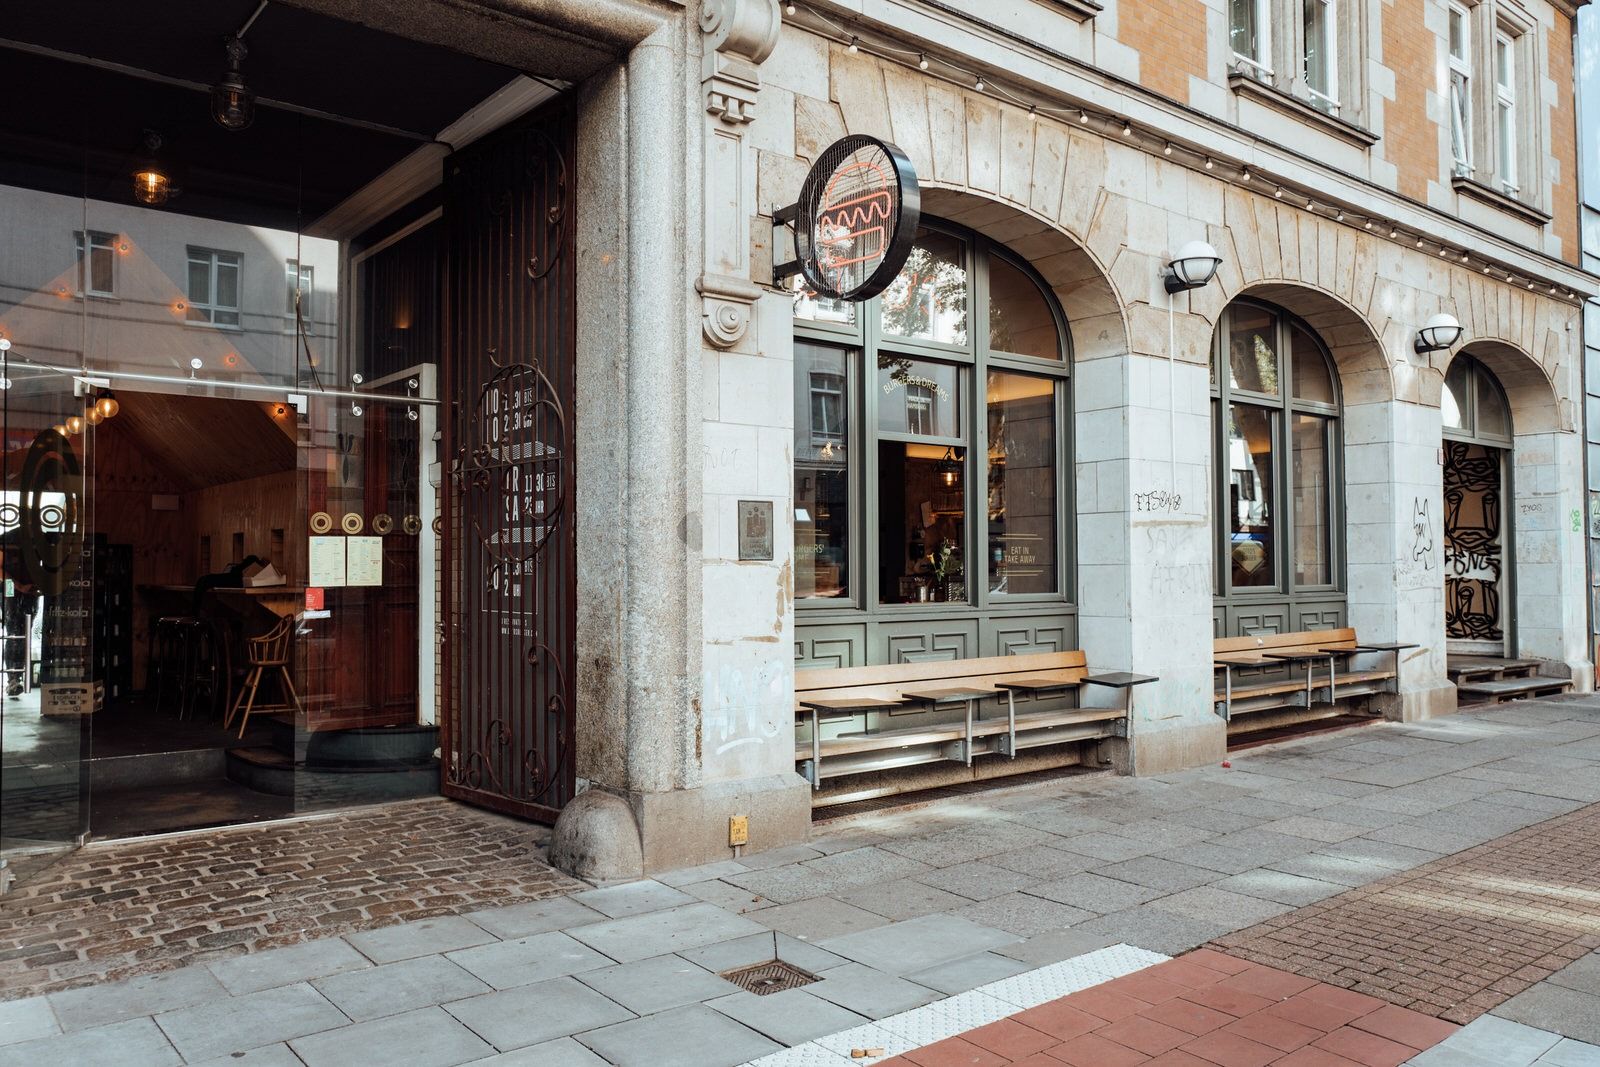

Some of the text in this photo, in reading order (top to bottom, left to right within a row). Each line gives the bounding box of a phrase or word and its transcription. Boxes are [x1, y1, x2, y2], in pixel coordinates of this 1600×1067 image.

[1010, 546, 1030, 555] EAT IN
[1004, 555, 1036, 564] TAKE AWAY
